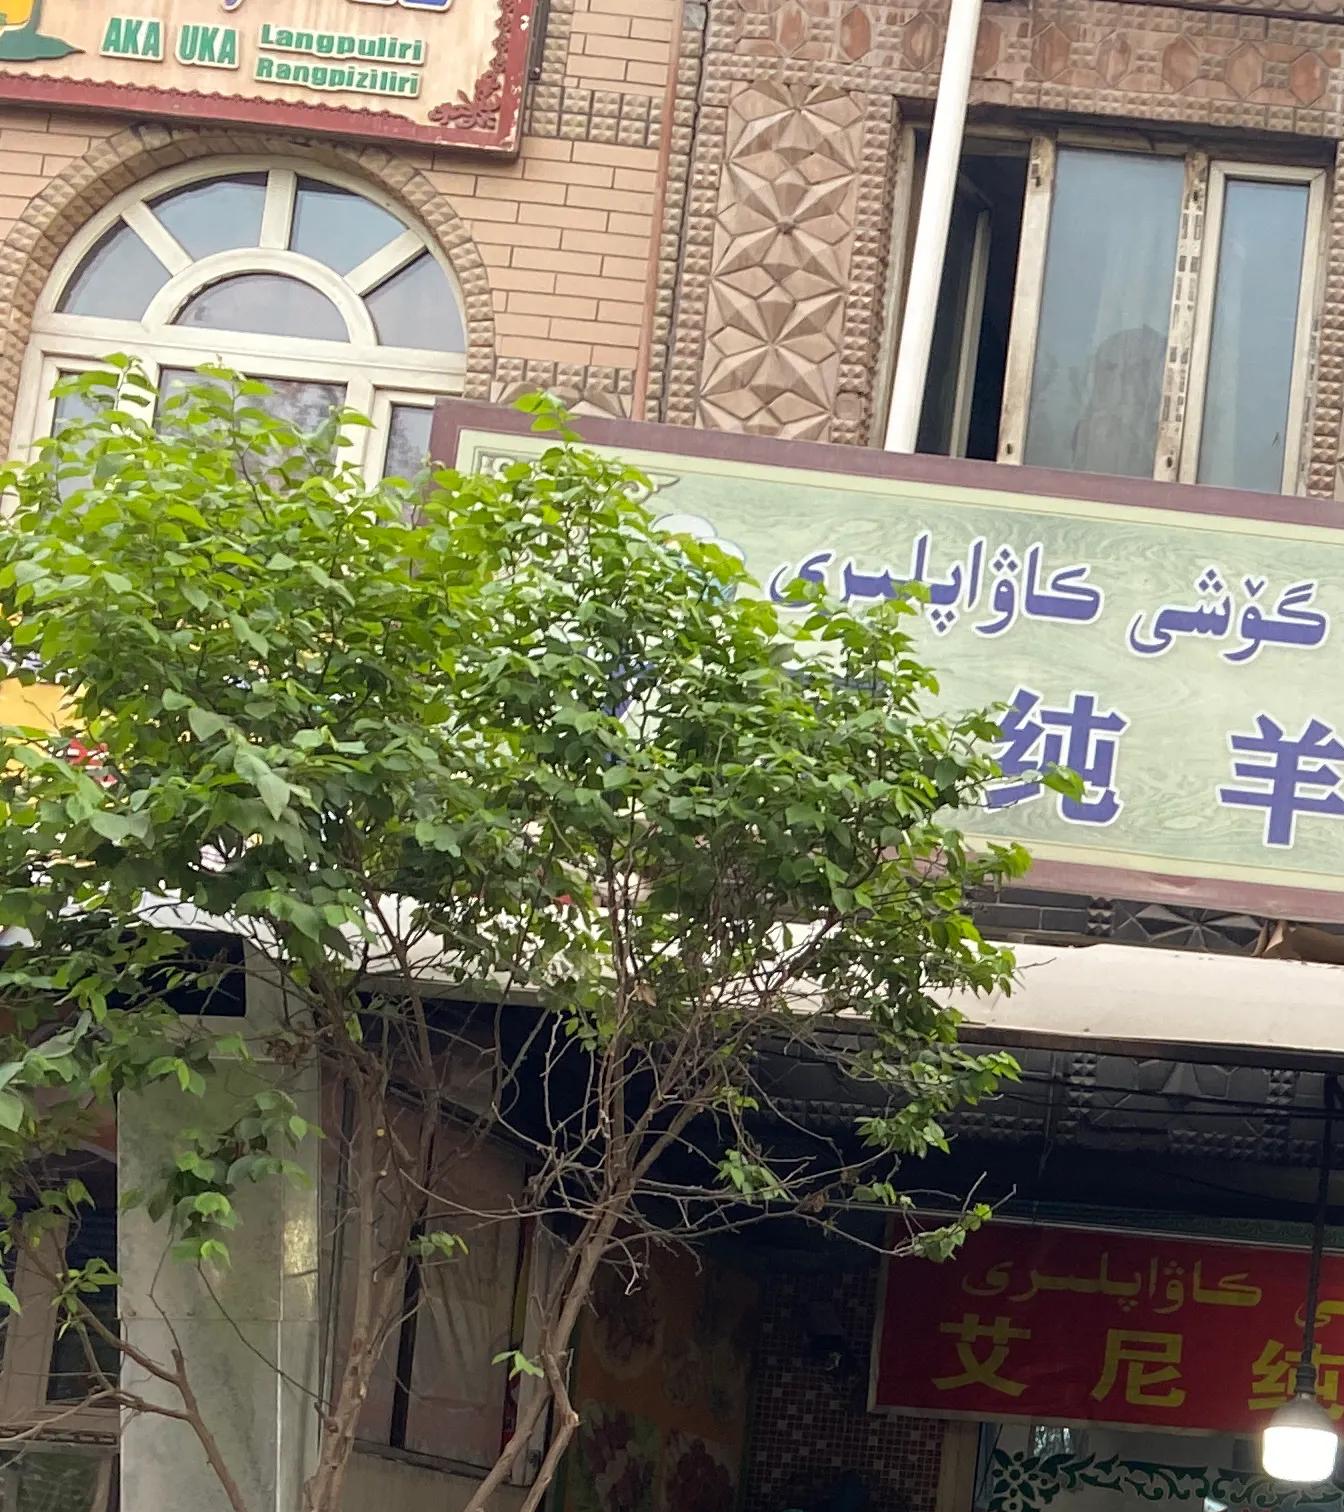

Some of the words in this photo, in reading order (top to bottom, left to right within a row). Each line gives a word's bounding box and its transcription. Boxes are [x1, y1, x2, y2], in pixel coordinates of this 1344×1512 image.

[102, 17, 161, 58] AKA
[179, 25, 237, 65] UKA
[260, 24, 422, 61] Langpuliri
[256, 57, 419, 95] Rangpiziliri
